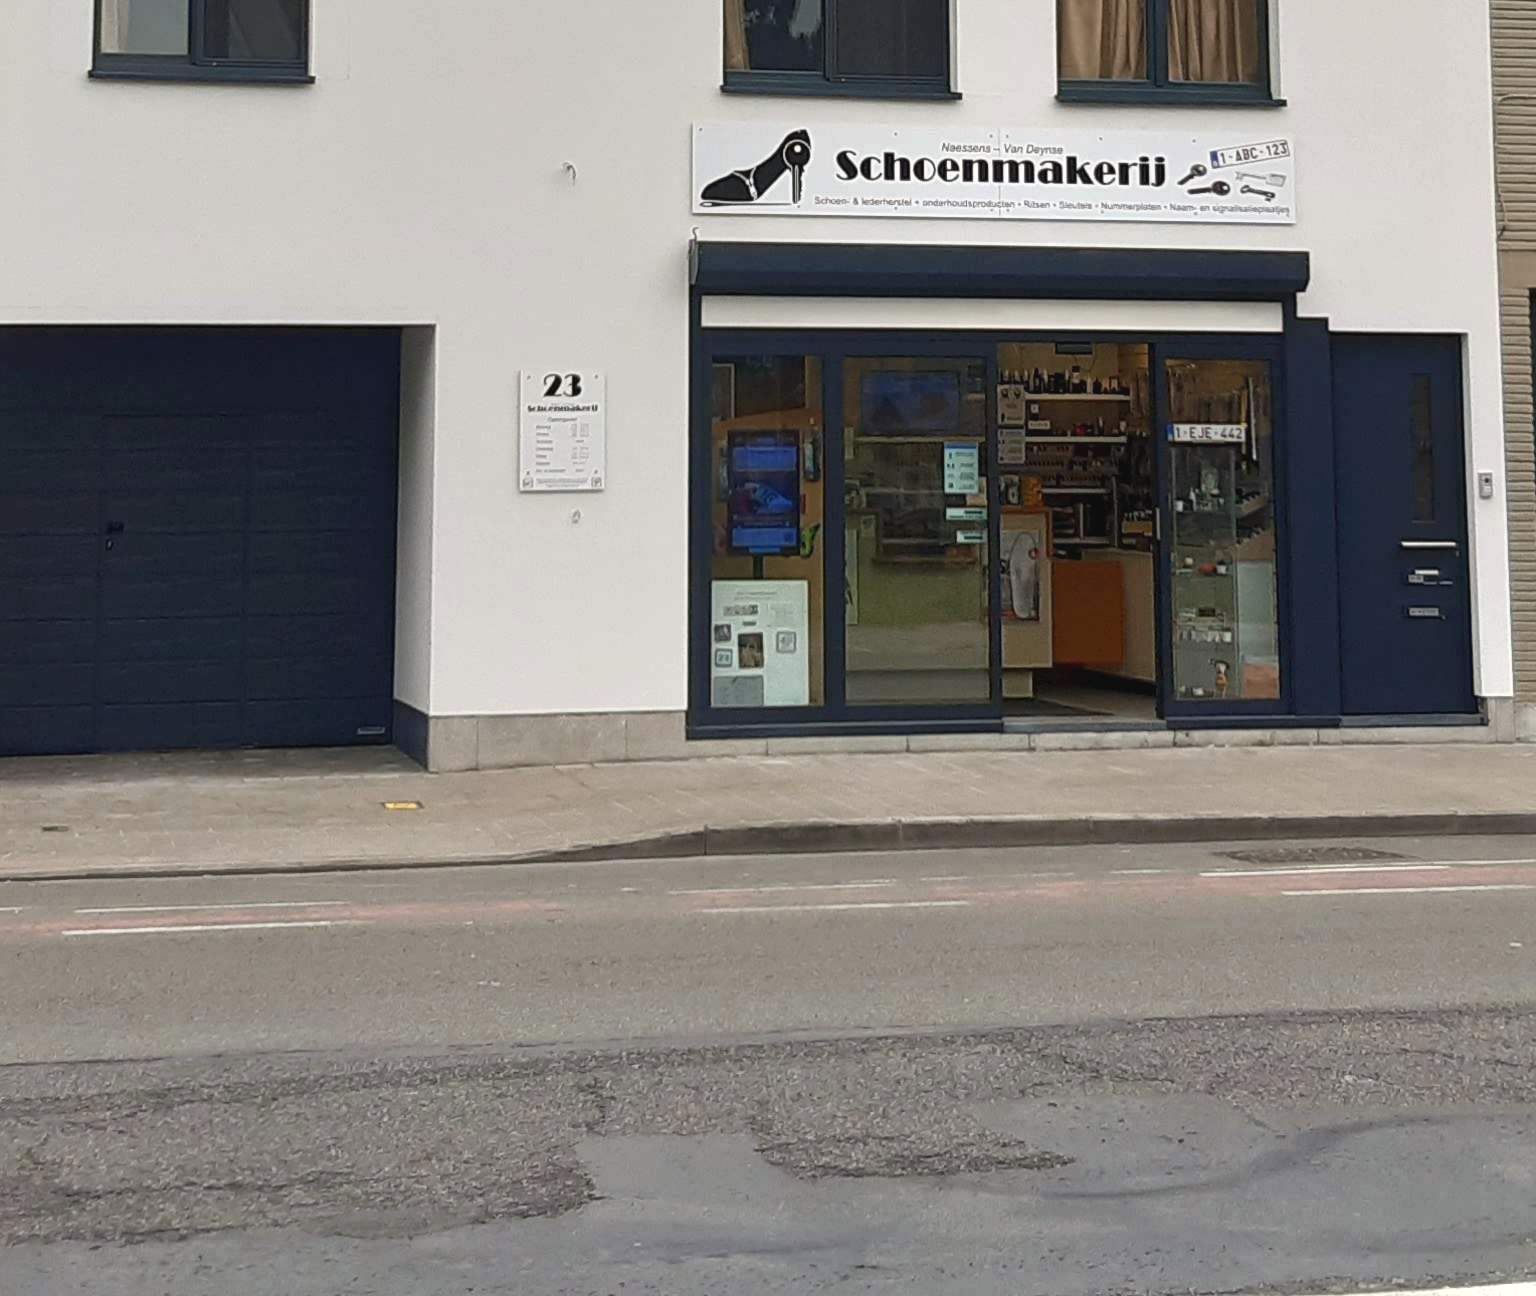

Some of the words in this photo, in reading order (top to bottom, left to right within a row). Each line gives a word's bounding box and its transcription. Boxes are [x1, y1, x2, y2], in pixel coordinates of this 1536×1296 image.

[941, 142, 991, 153] Naessens
[1004, 144, 1023, 153] Van
[1026, 144, 1064, 156] Deynse
[836, 150, 1166, 187] Schoenmakerij
[543, 373, 582, 397] 23
